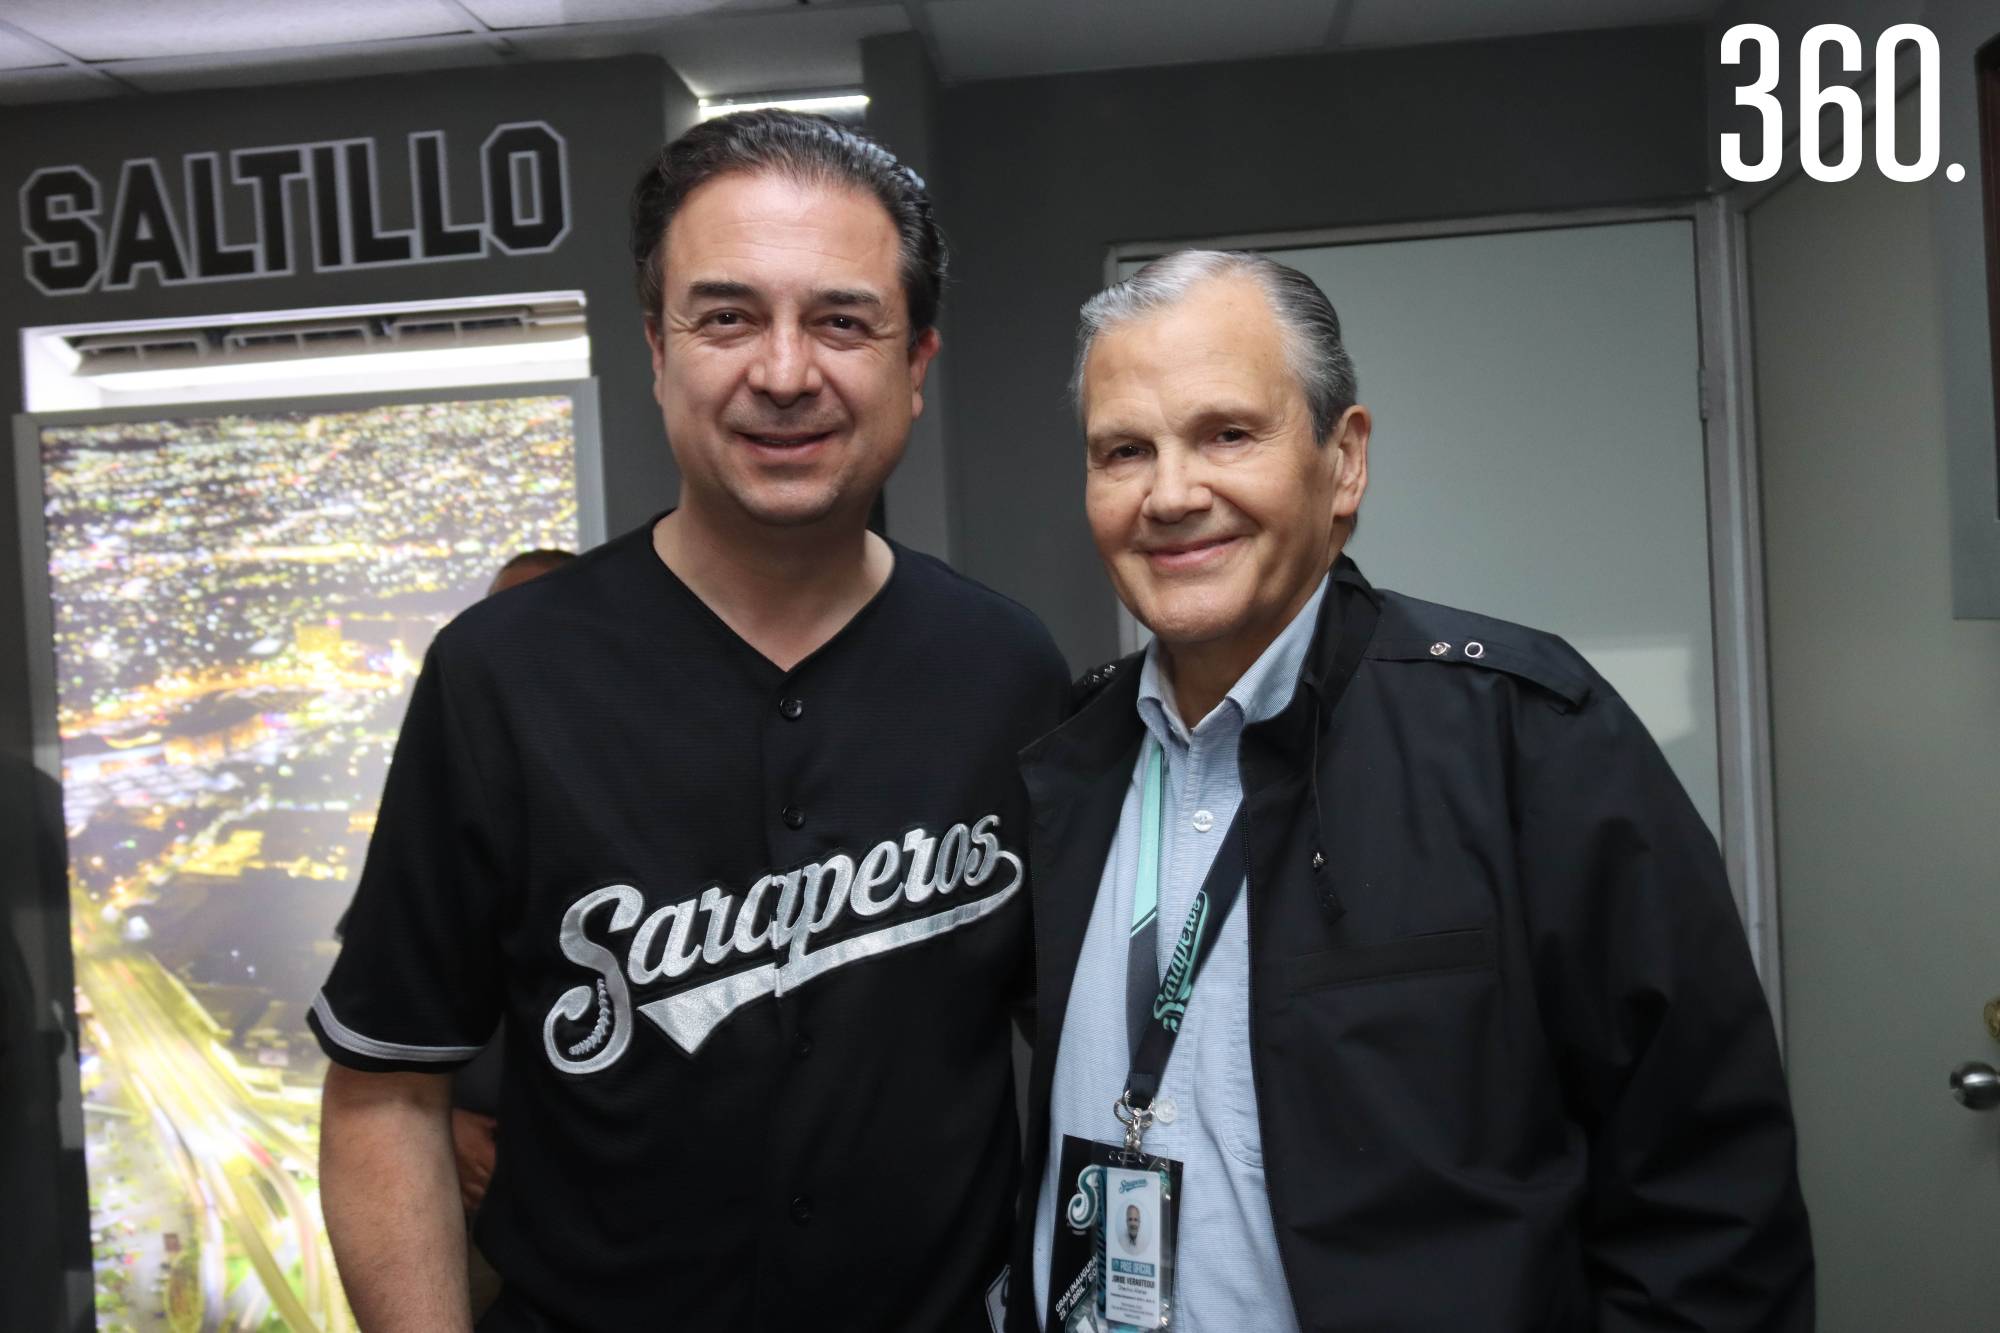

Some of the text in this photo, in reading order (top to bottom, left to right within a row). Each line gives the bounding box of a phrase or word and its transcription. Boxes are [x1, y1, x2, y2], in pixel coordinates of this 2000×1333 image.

[19, 120, 571, 297] SALTILLO
[543, 814, 1024, 1075] Saraperos
[1153, 890, 1208, 1033] Saraperos
[1055, 1290, 1071, 1312] GRAN
[1070, 1285, 1086, 1308] ABRIL
